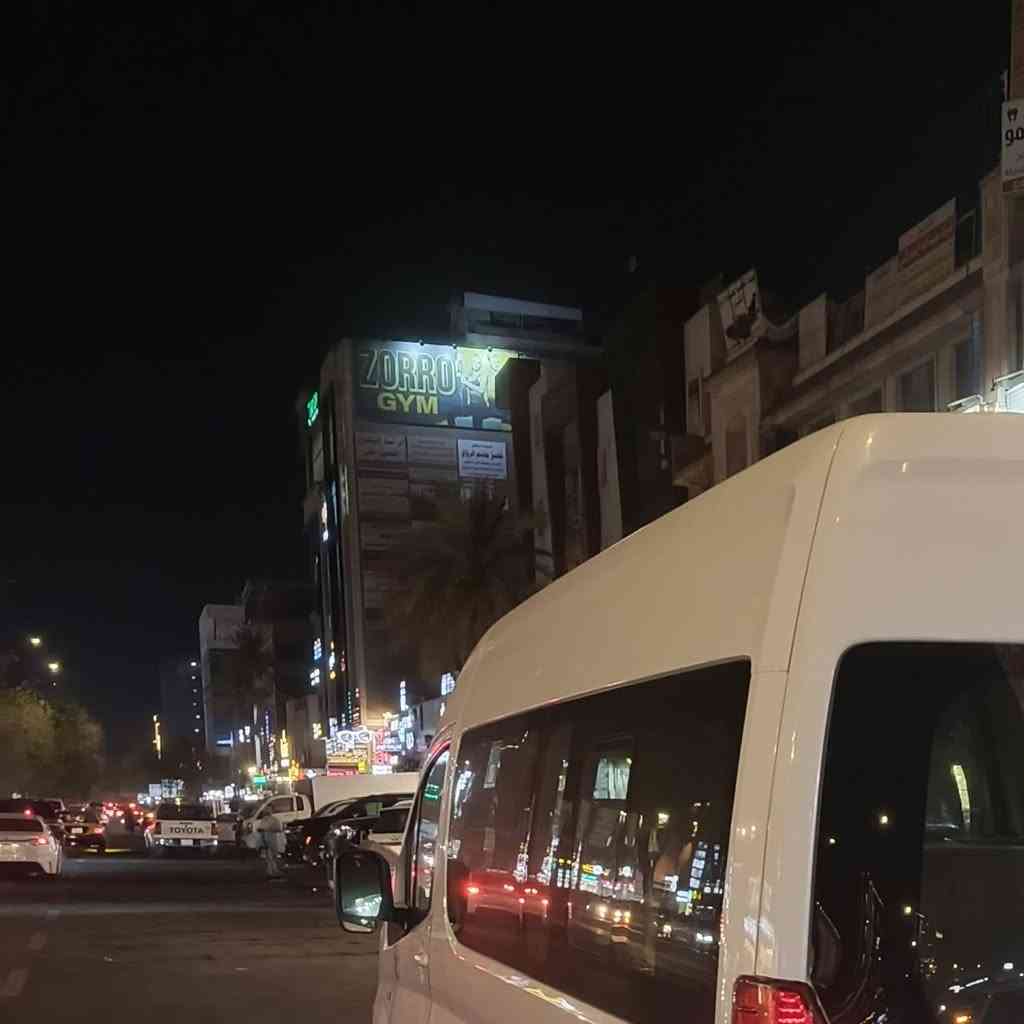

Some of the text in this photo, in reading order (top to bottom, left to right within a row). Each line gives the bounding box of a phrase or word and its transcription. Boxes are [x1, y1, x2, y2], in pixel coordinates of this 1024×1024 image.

[359, 349, 456, 396] ZORRO
[376, 392, 440, 415] GYM
[169, 826, 205, 834] TOYOTA
